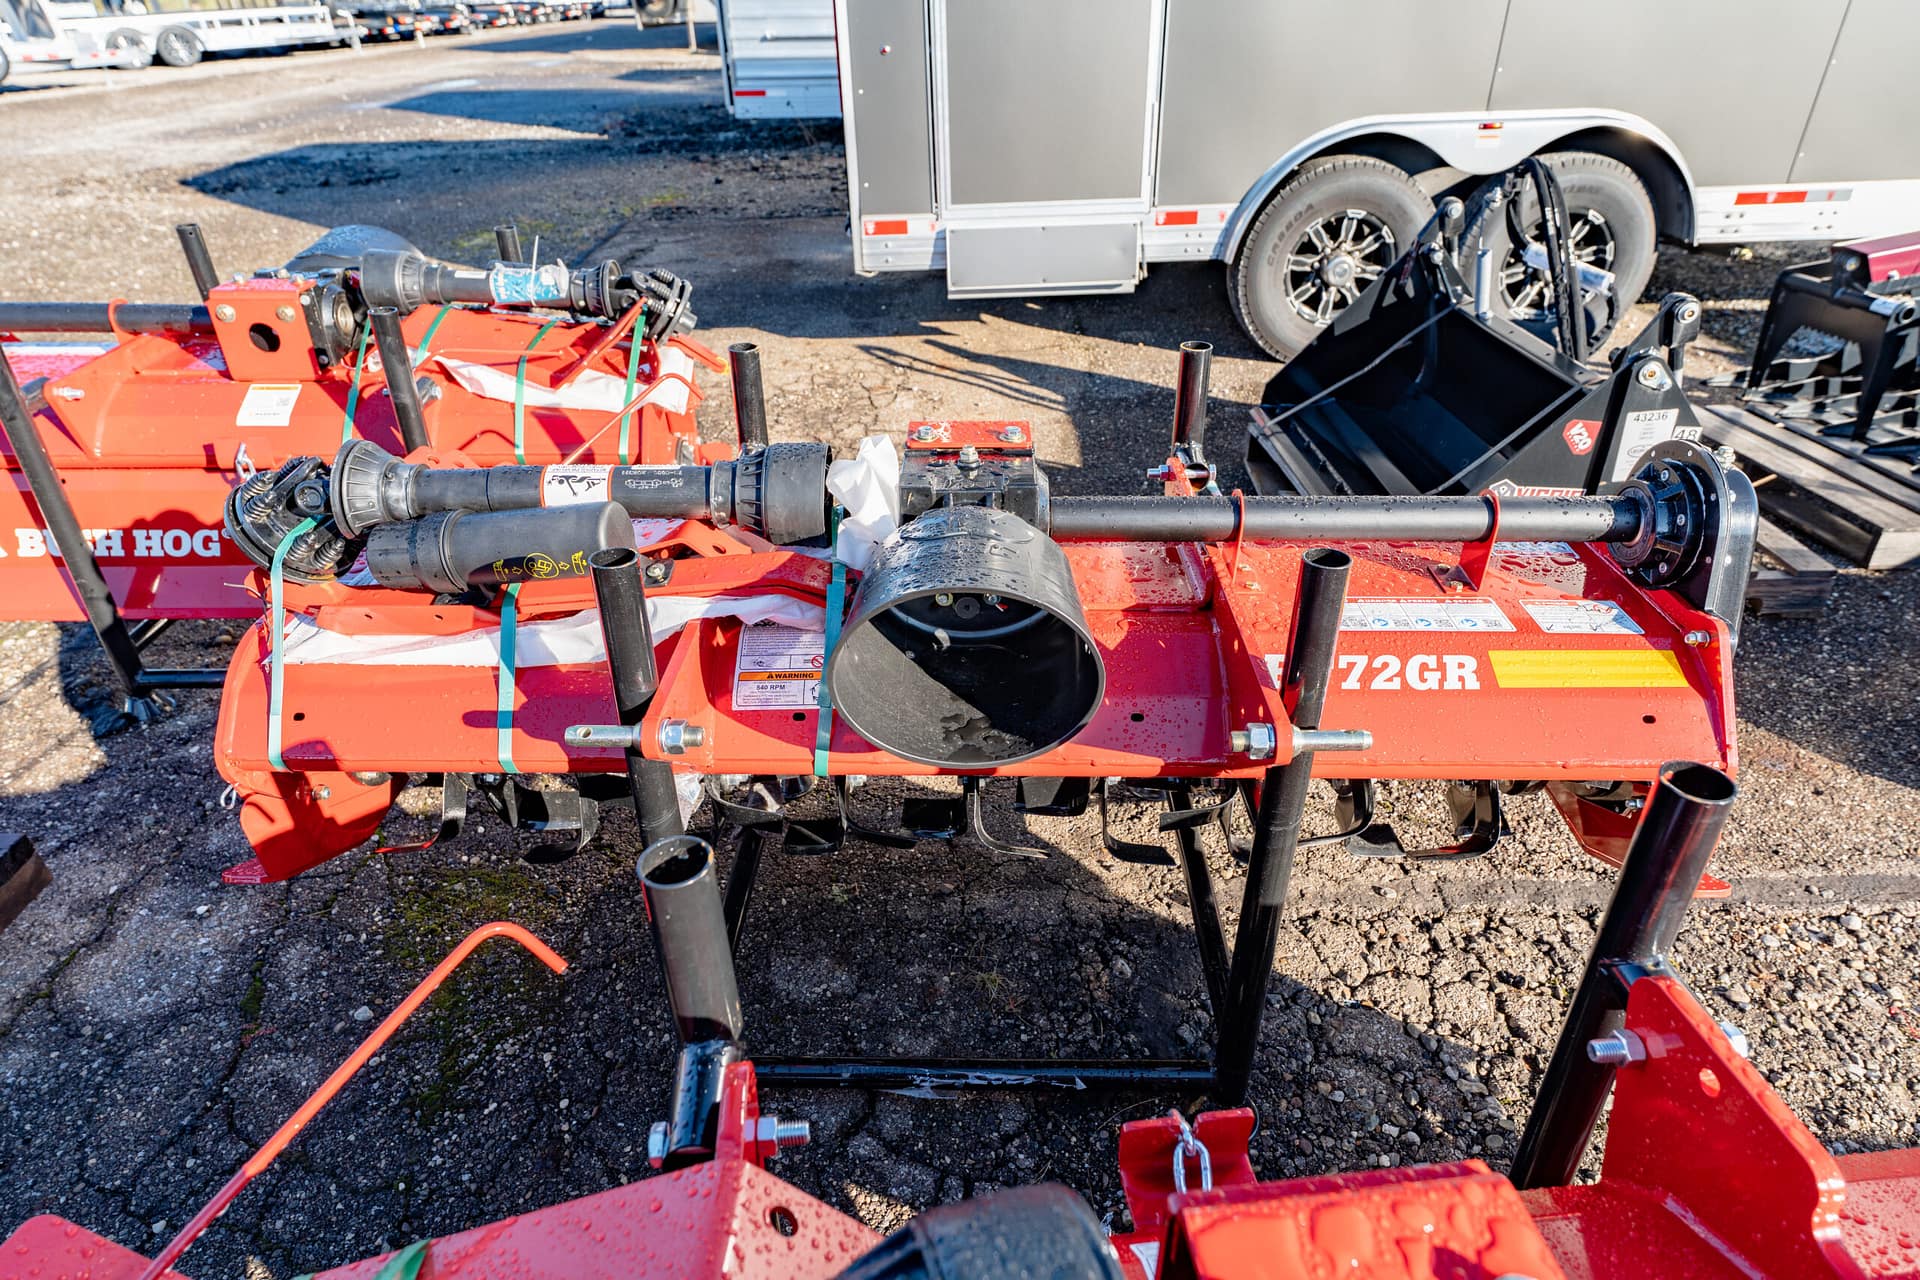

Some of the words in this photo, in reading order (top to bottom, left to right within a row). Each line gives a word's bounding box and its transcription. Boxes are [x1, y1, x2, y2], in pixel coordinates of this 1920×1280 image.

[1633, 411, 1668, 422] 43236
[1674, 429, 1698, 441] 48
[133, 529, 221, 557] HOG
